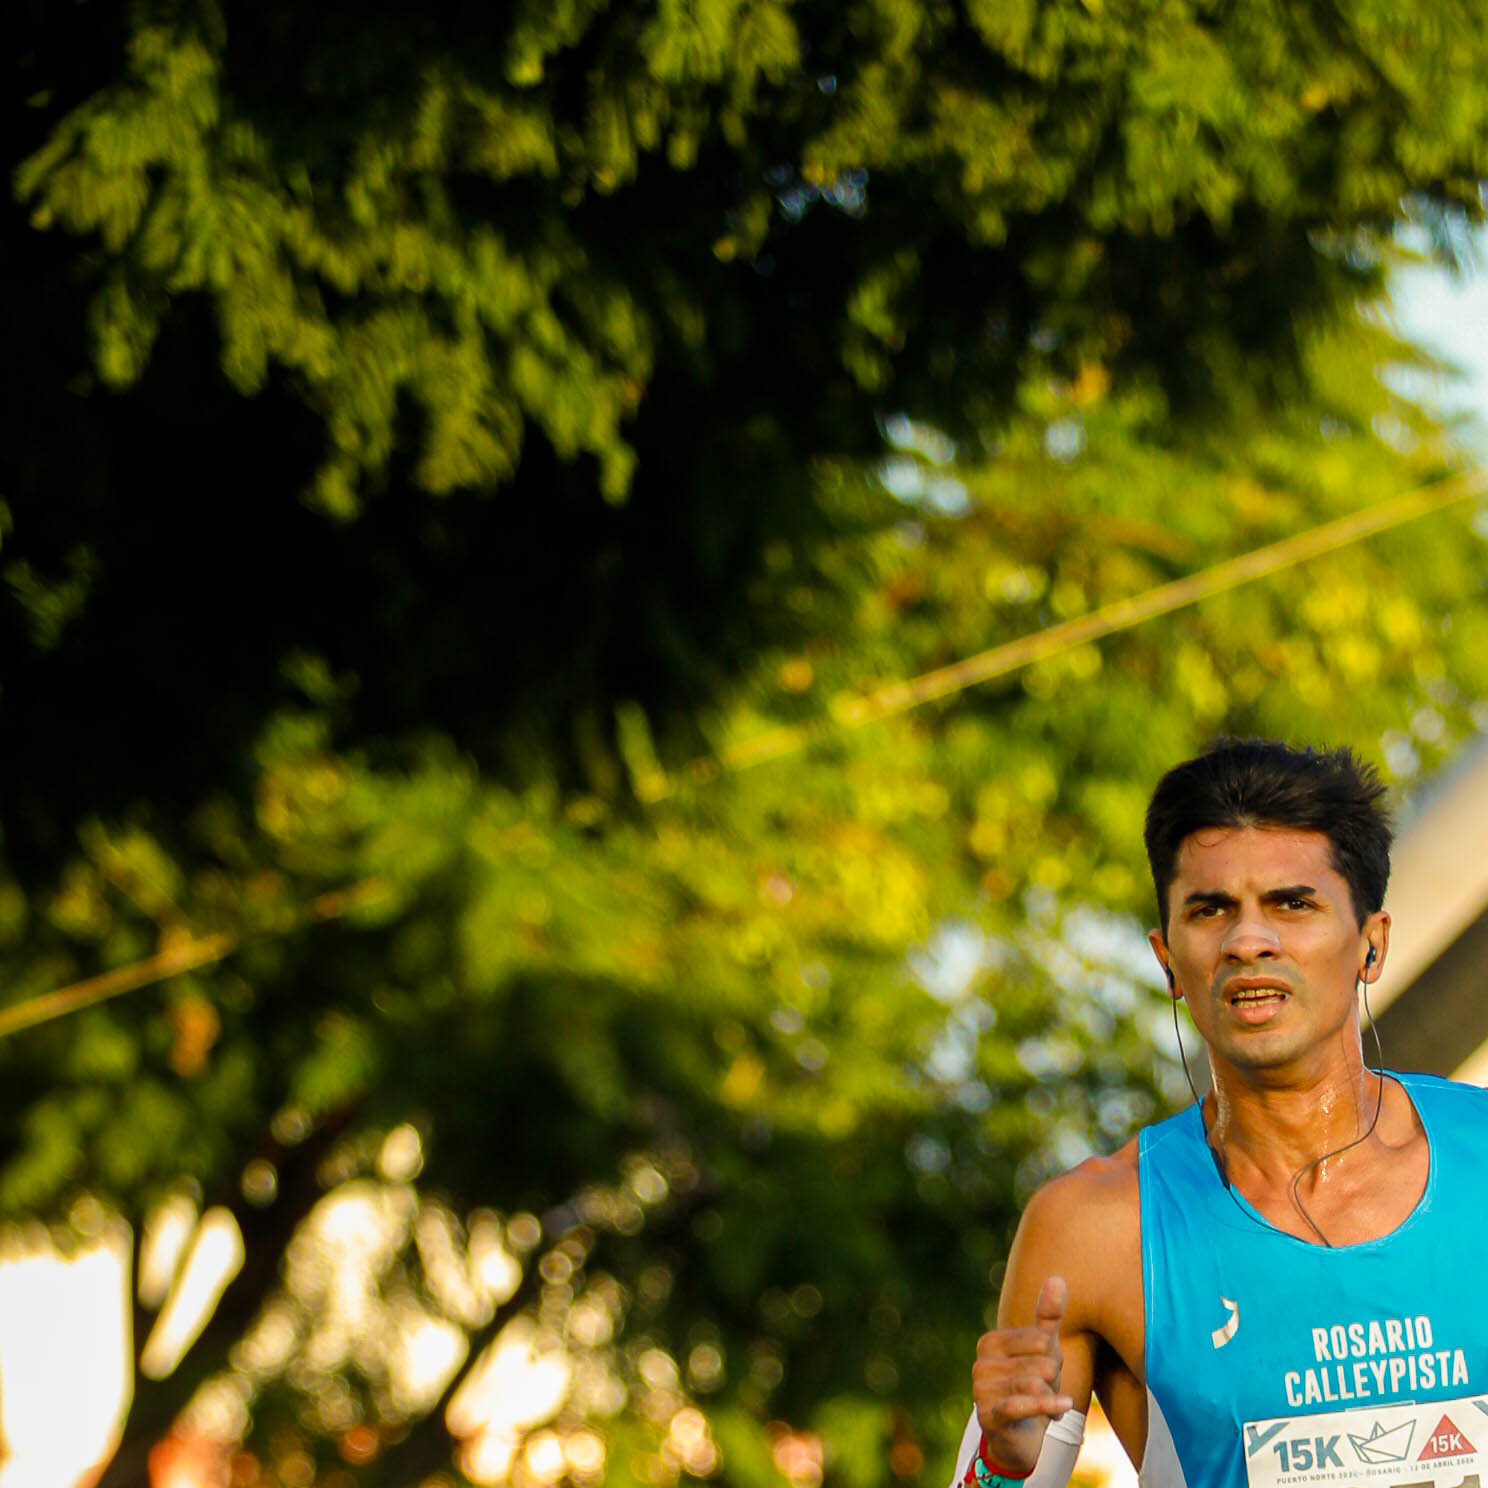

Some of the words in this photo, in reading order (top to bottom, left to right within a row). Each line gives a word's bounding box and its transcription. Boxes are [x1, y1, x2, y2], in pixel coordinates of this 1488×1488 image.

[1311, 1315, 1433, 1362] ROSARIO
[1284, 1349, 1469, 1407] CALLEYPISTA
[1273, 1434, 1345, 1473] 15K
[1430, 1433, 1463, 1454] 15K
[1276, 1475, 1307, 1484] PUERTO
[1310, 1473, 1336, 1481] NORTE
[1433, 1460, 1454, 1469] ABRIL
